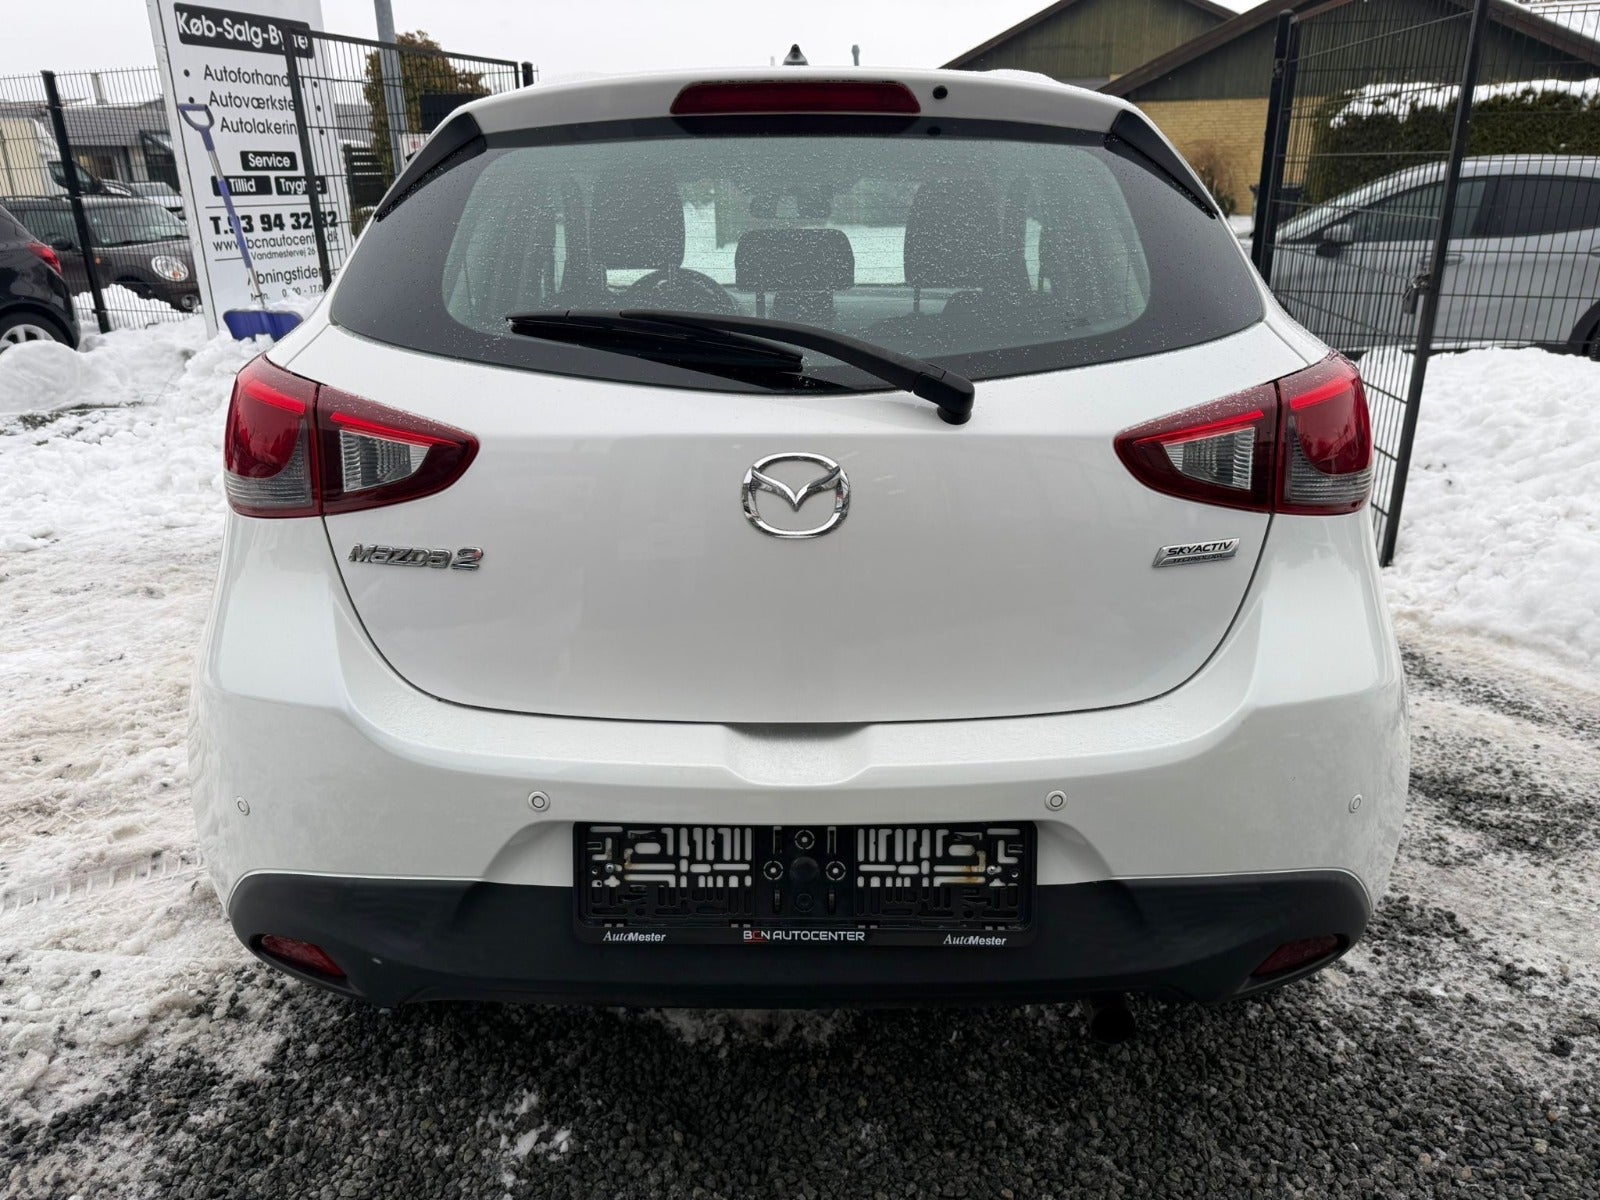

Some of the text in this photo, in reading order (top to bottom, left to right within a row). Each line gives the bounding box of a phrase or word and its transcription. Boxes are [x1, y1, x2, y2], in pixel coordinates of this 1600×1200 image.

[220, 117, 298, 135] Autolakerin
[248, 153, 291, 168] Service
[229, 178, 256, 192] Tillid
[260, 213, 285, 232] 94
[290, 212, 313, 230] 32
[251, 247, 316, 260] Vandmestervej 26
[1167, 541, 1233, 556] SKYACTIV
[603, 930, 666, 942] AutoMester
[743, 930, 866, 941] BCN AUTOCENTER
[943, 933, 1007, 945] AutoMester
